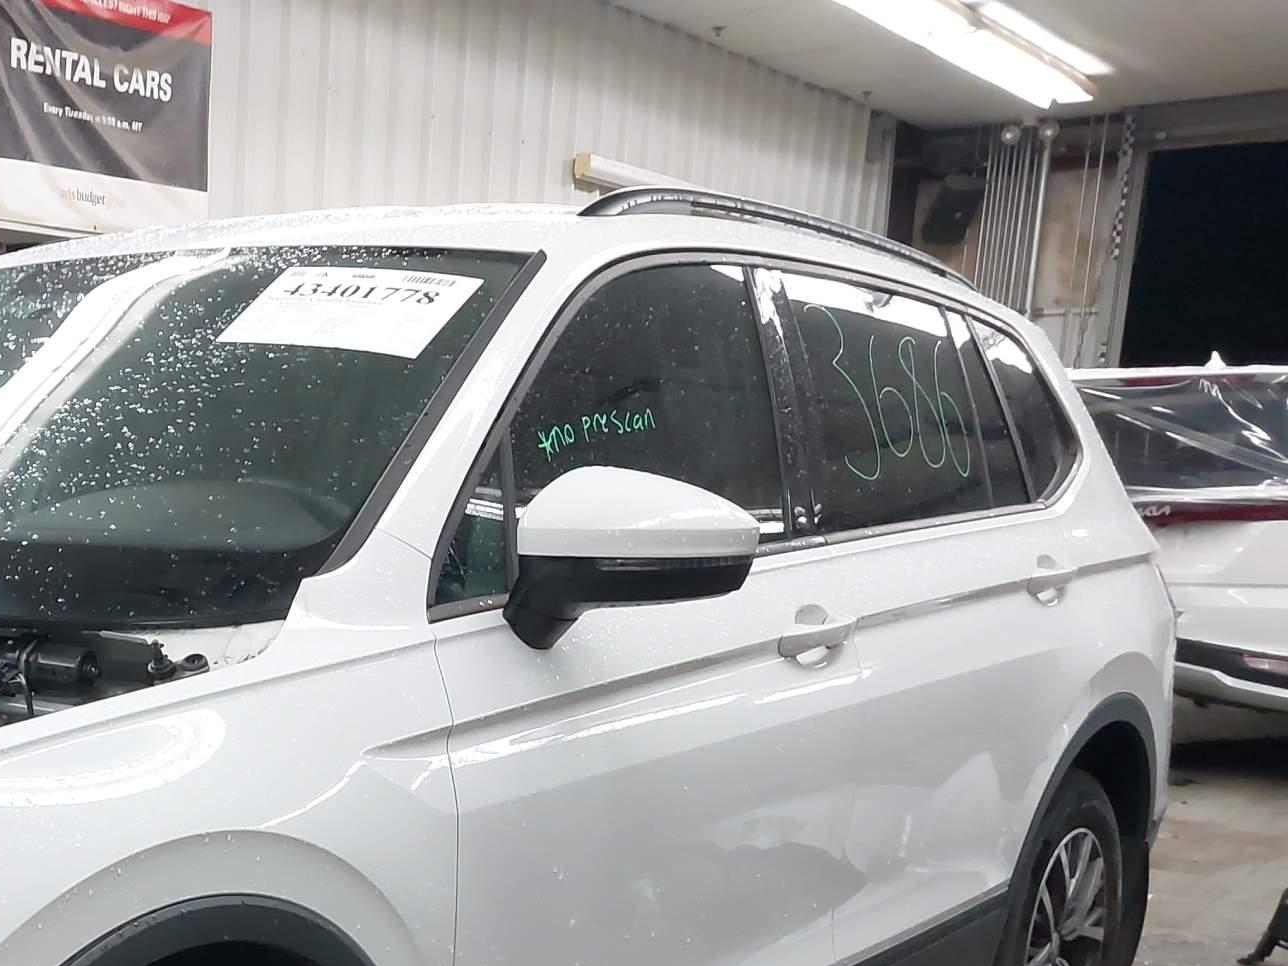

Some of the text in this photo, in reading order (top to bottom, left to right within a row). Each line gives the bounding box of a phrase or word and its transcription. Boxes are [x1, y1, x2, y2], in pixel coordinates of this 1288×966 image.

[10, 37, 173, 102] RENTAL CARS
[283, 282, 441, 304] 43401778
[804, 304, 971, 480] 3686
